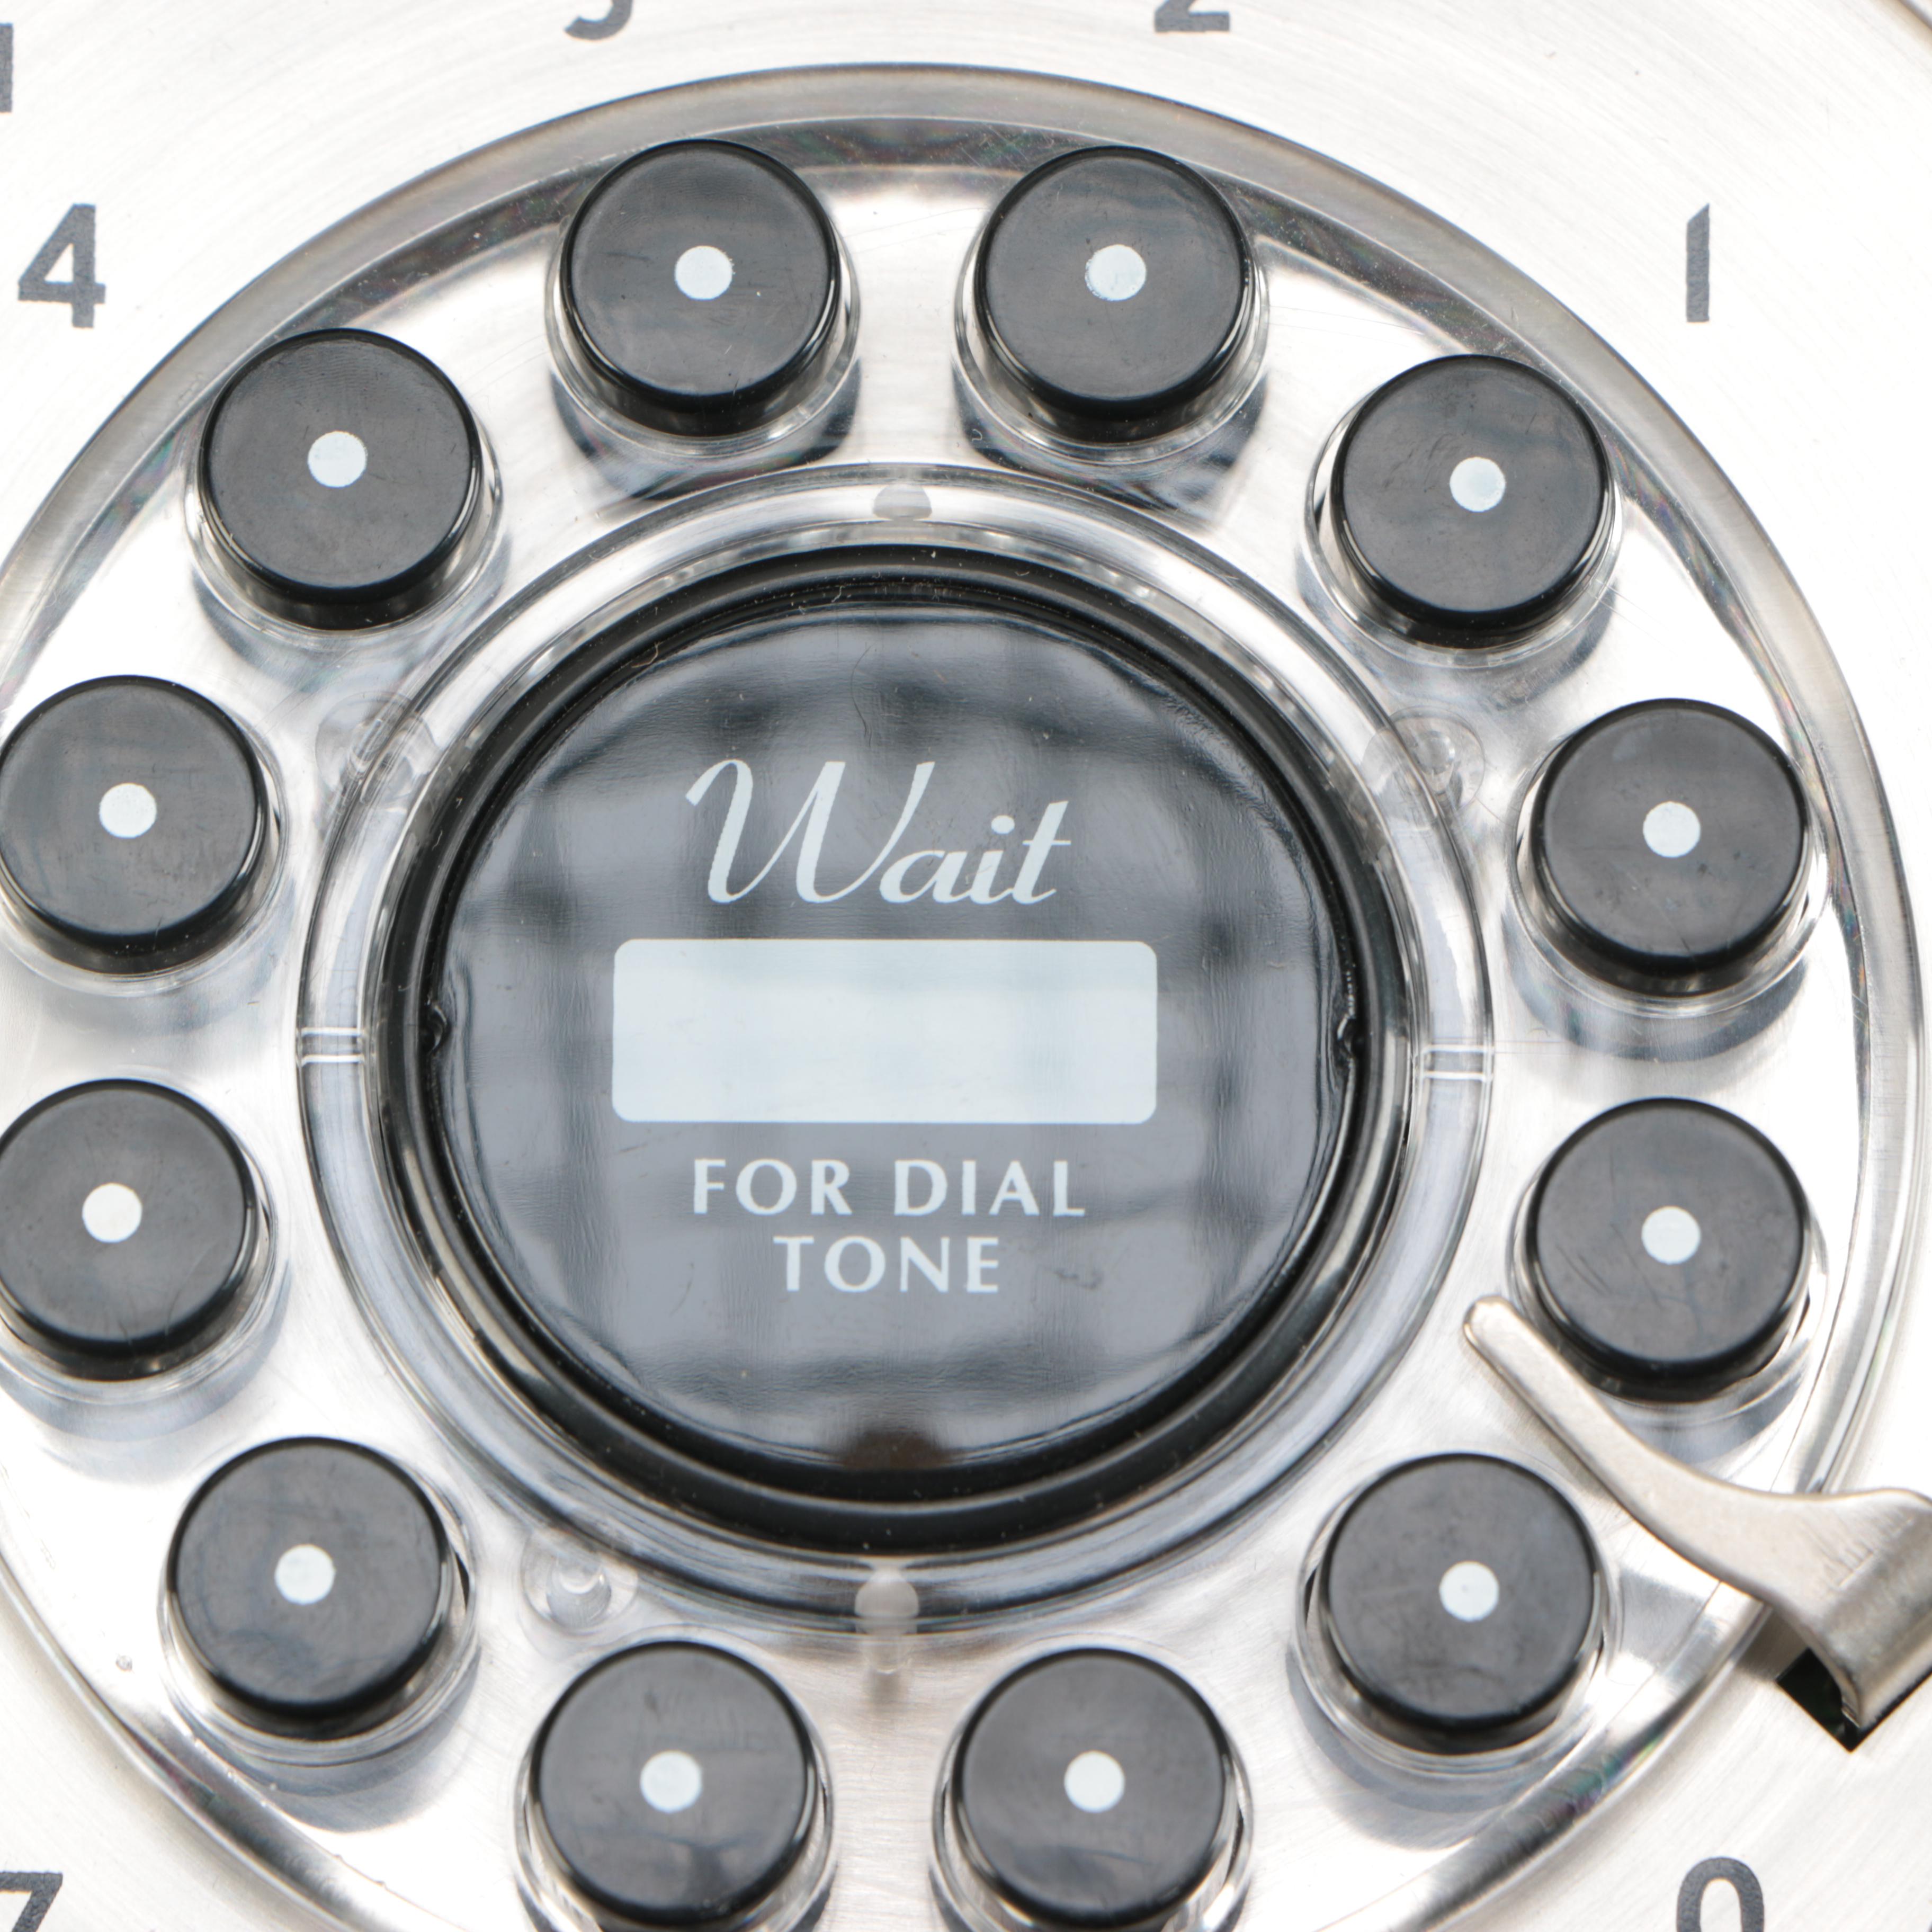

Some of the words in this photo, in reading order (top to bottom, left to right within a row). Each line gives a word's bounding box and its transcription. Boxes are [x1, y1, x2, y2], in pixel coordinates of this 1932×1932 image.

[19, 204, 105, 328] 4
[1687, 204, 1710, 322] 1
[685, 759, 1071, 904] Wait
[693, 1158, 852, 1215] FOR
[894, 1159, 1085, 1216] DIAL
[773, 1236, 999, 1293] TONE
